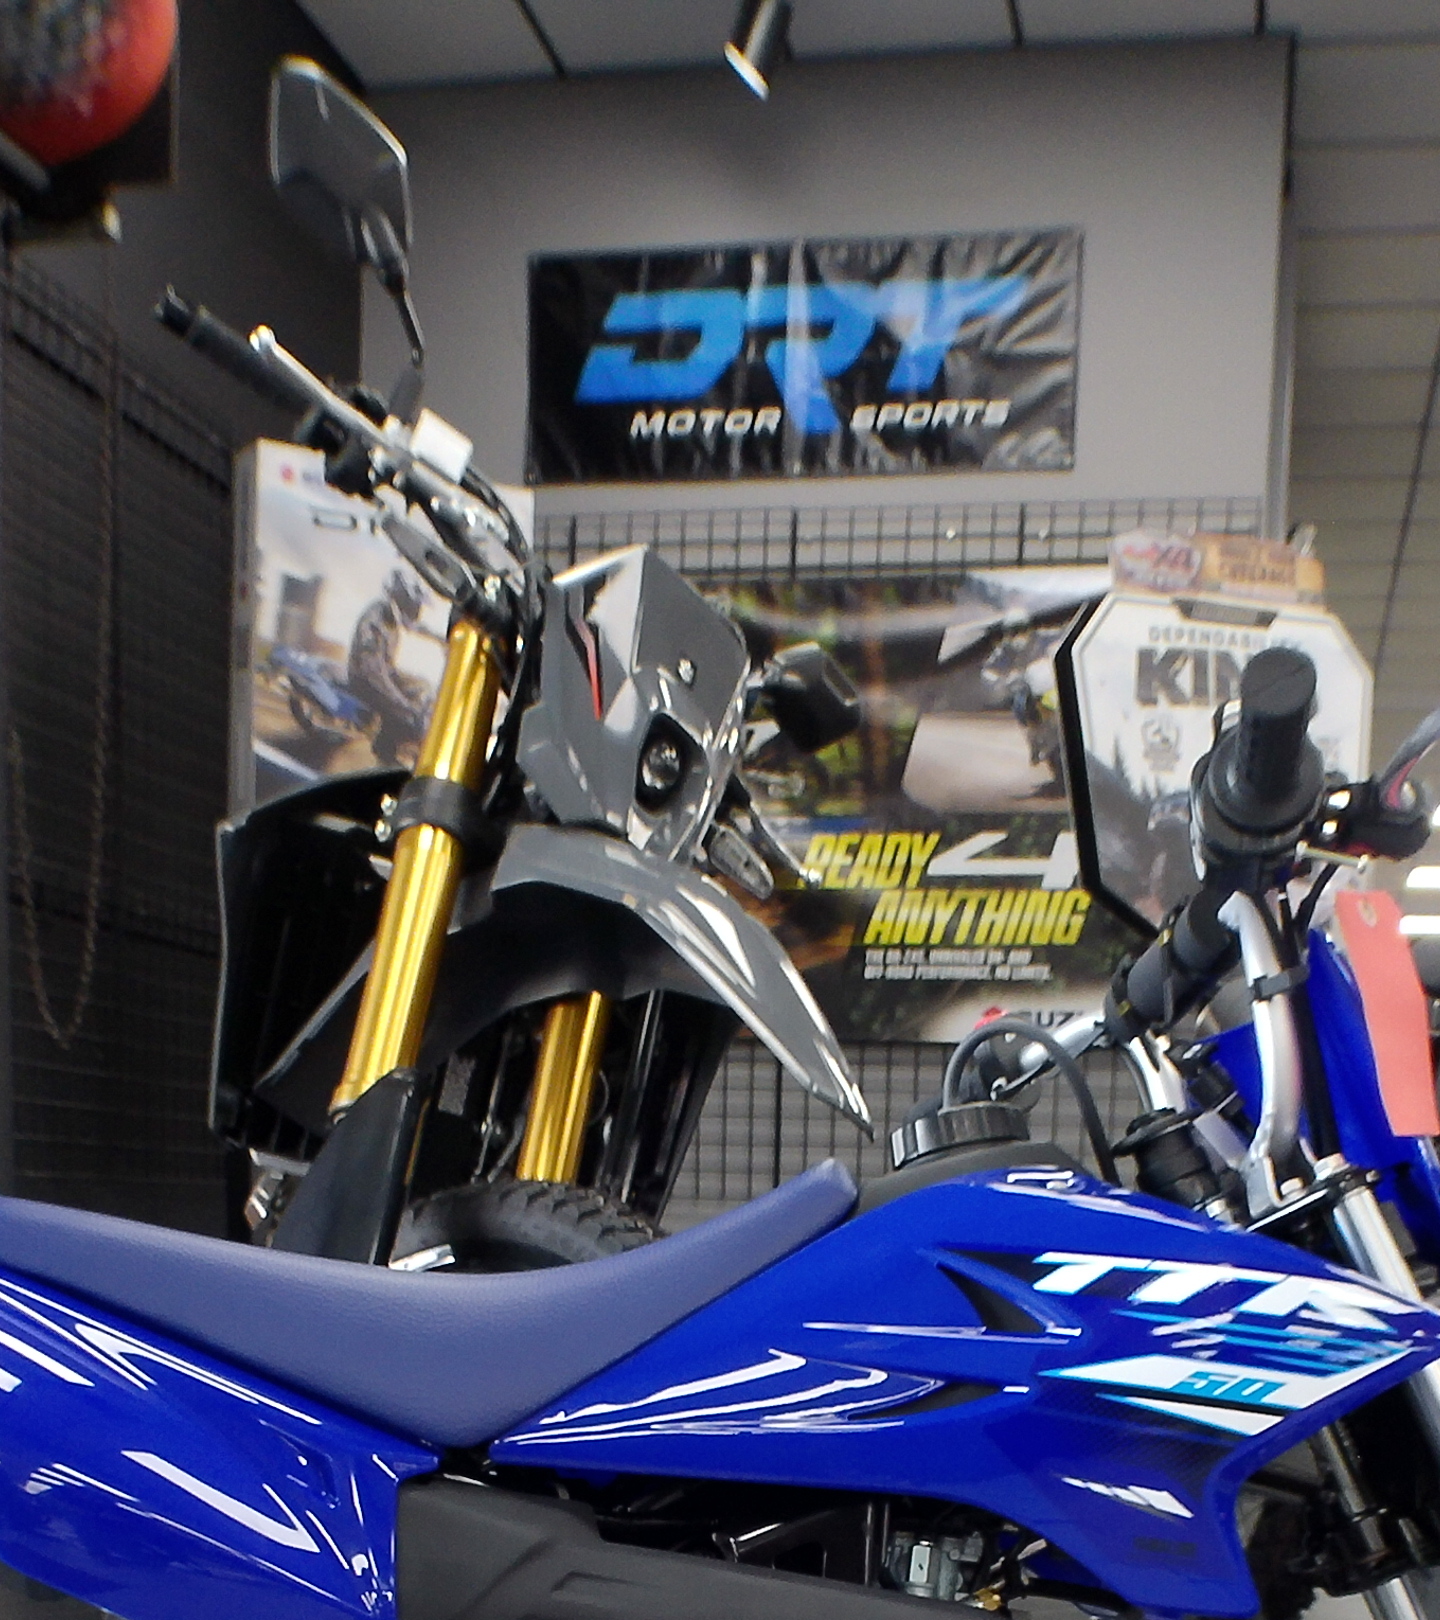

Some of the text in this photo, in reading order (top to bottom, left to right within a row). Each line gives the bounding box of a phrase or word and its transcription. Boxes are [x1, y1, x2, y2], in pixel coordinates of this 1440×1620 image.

[629, 399, 1011, 440] MOTOR SPORTS
[797, 830, 1081, 891] READY 4
[863, 888, 1093, 946] ANYTHING
[1170, 1371, 1287, 1403] 50
